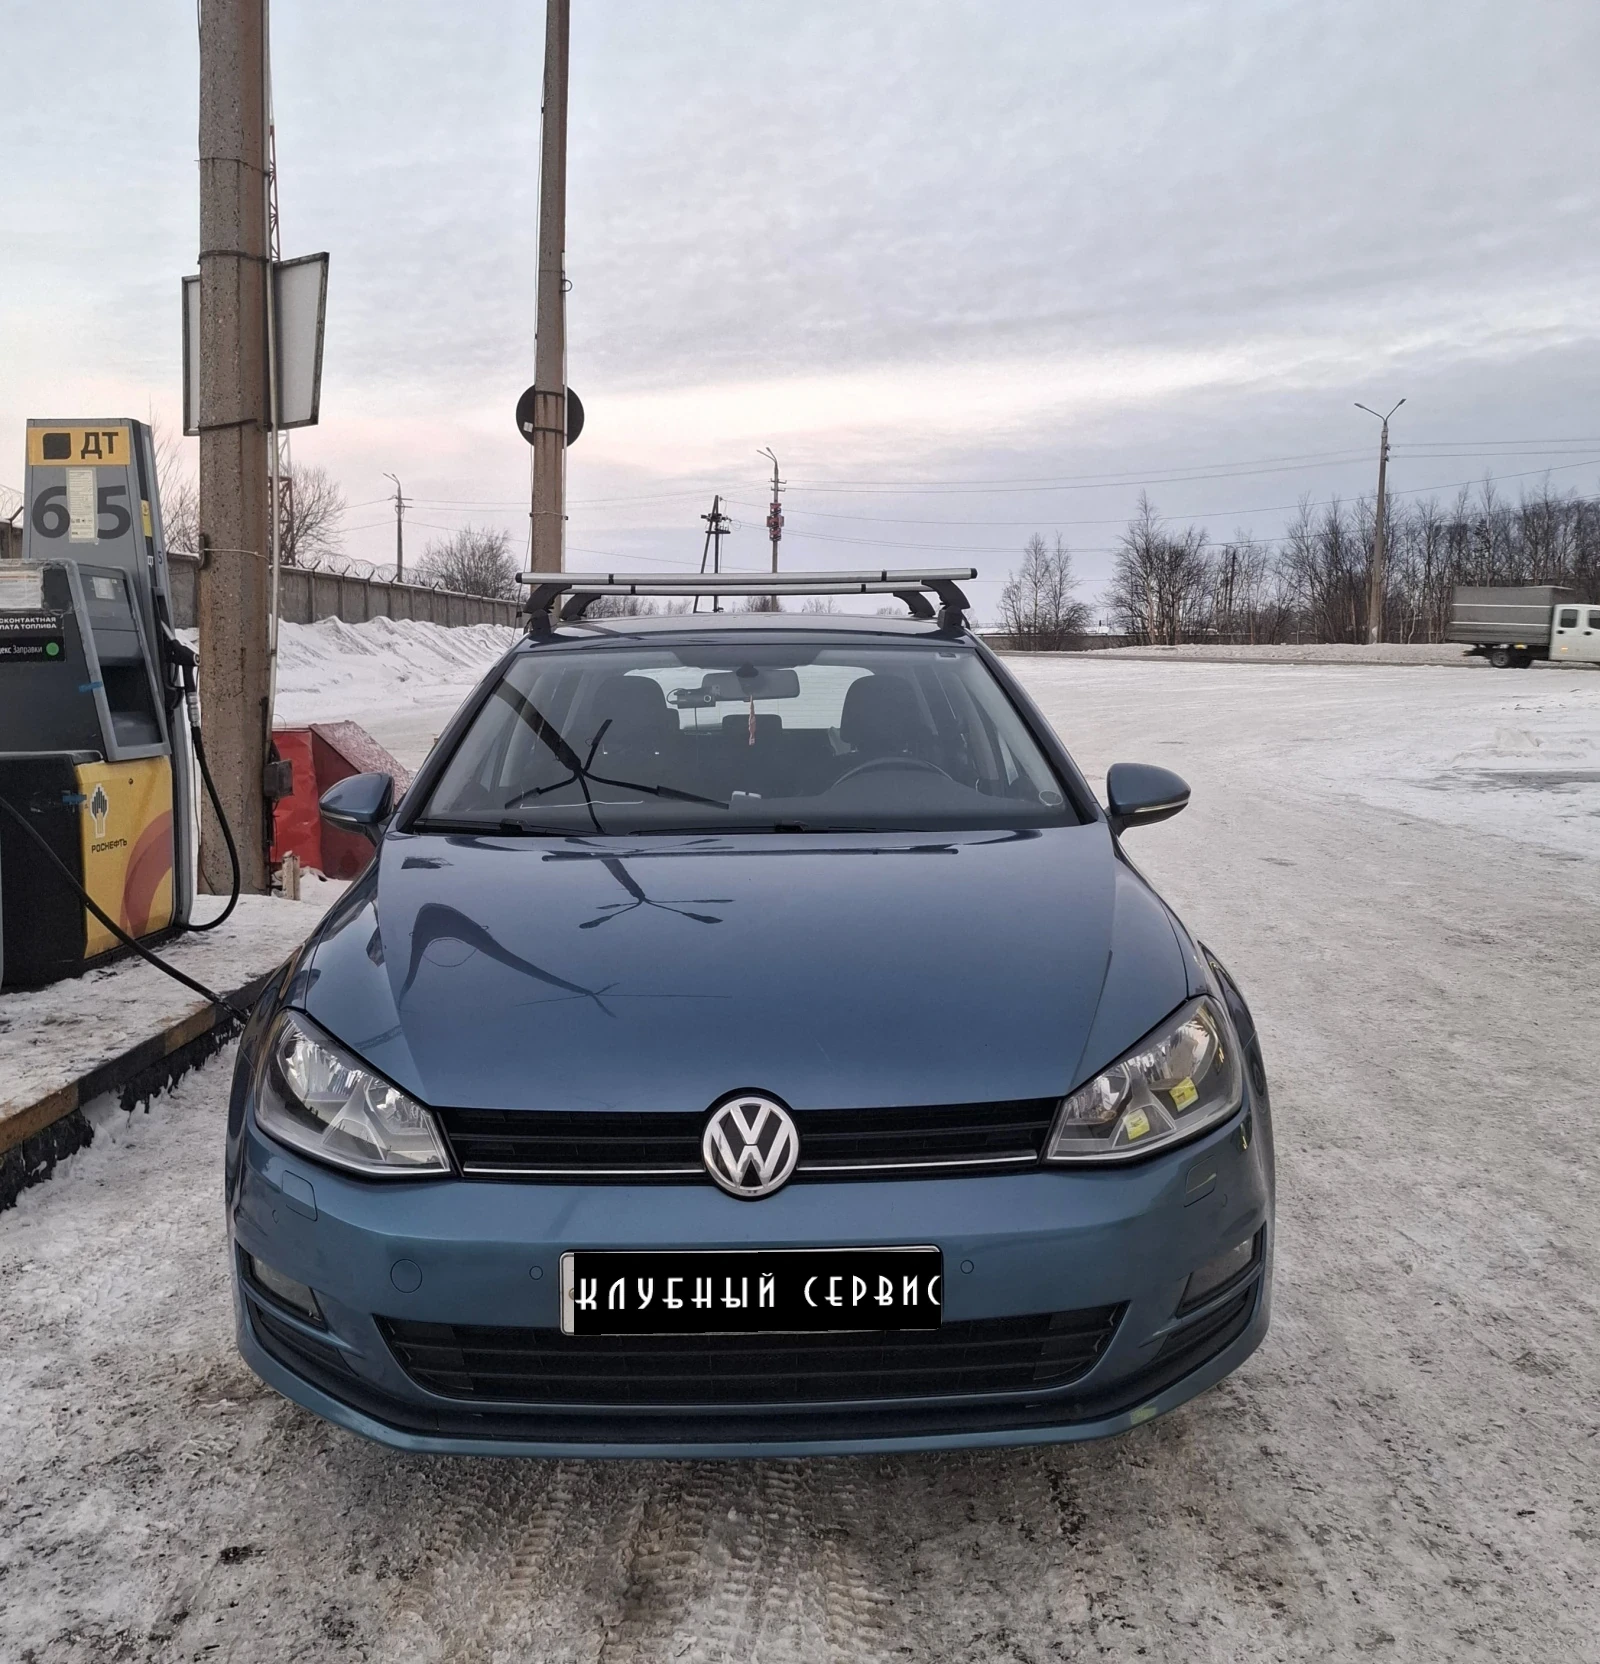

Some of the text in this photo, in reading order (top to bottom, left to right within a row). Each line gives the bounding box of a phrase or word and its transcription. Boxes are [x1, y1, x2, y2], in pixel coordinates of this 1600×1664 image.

[80, 431, 119, 459] ДТ
[0, 644, 43, 655] екс Заправки
[91, 838, 128, 854] РОСНЕФТЬ
